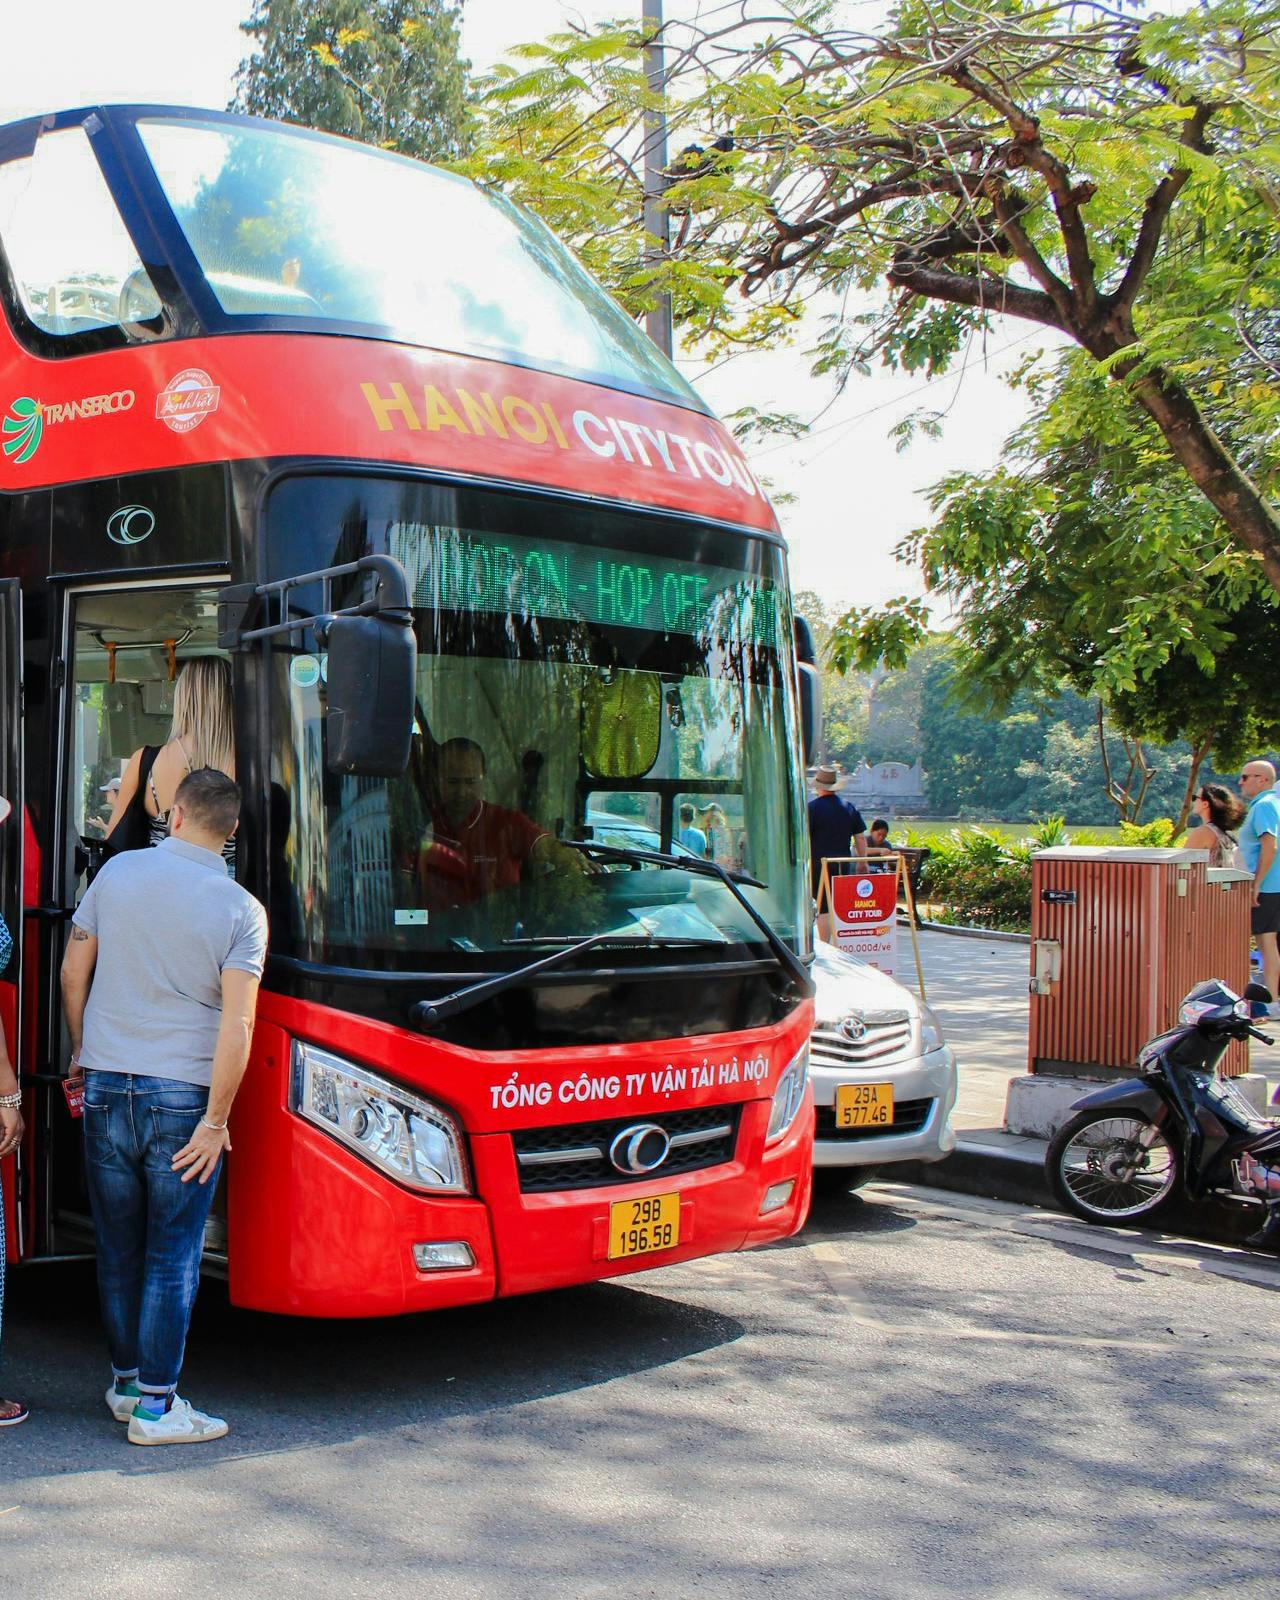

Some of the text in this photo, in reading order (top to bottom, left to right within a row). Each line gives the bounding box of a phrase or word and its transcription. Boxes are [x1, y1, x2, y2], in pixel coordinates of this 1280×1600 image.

[43, 389, 135, 426] TRANSERCO
[360, 382, 768, 504] HANOI CITYTOU
[441, 539, 514, 611] HOP
[524, 551, 569, 618] ON
[597, 561, 653, 624] HOP
[662, 573, 709, 631] OFF
[847, 909, 882, 919] CITY TOUR
[854, 899, 876, 909] HANOI
[839, 943, 891, 953] 00.000đ/vé
[490, 1053, 769, 1109] TỔNG CÔNG TY VẬN TẢI HÀ NỘI
[854, 1087, 878, 1105] 29A
[844, 1106, 887, 1124] 577.46
[632, 1199, 661, 1226] 29B
[620, 1223, 672, 1254] 196.58
